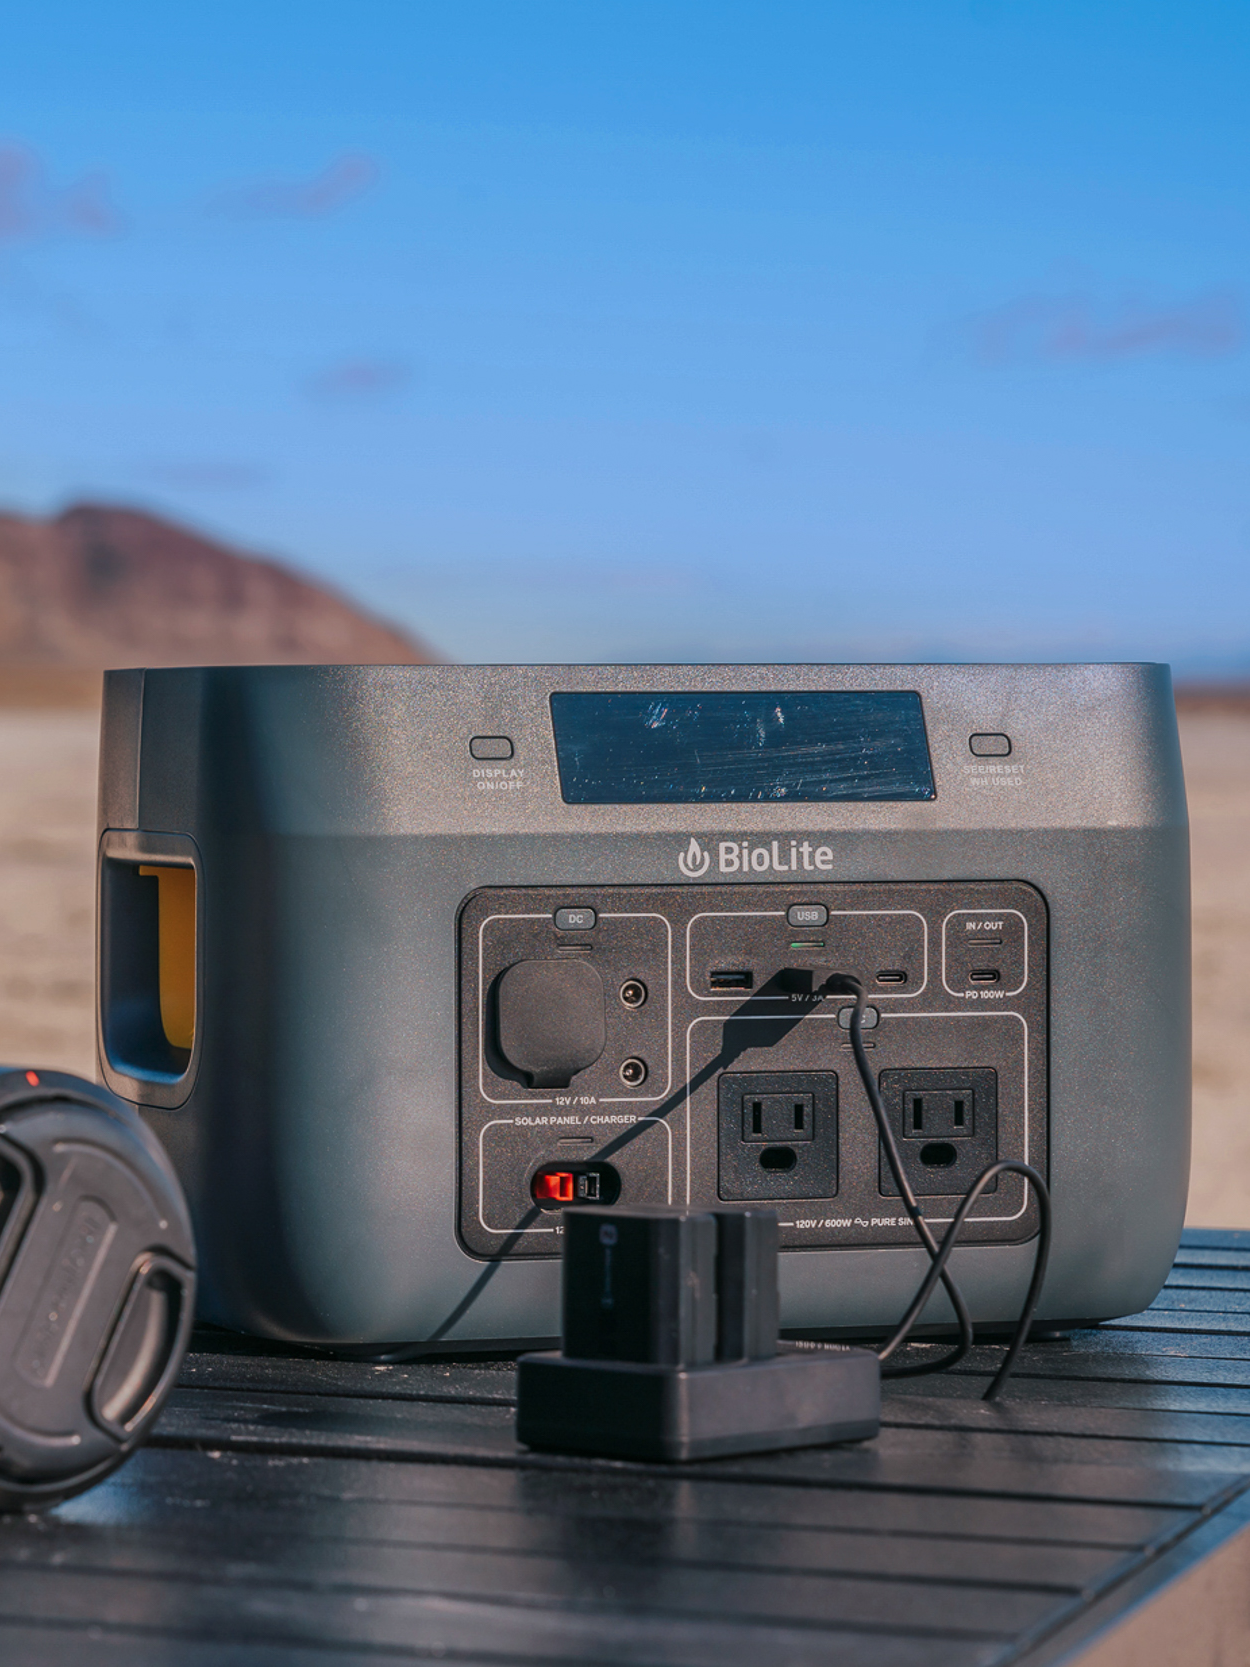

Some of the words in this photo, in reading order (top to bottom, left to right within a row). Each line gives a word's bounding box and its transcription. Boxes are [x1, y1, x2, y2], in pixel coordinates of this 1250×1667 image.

[472, 769, 524, 778] DISPLAY
[992, 777, 1023, 786] USED
[718, 840, 834, 873] BioLite
[568, 914, 584, 924] DC
[796, 911, 819, 921] USB
[983, 920, 1004, 930] OUT
[791, 993, 804, 1002] 5V
[965, 990, 978, 999] PD
[979, 990, 1005, 999] 100W
[555, 1096, 572, 1106] 12V
[579, 1096, 597, 1105] 10A
[514, 1116, 549, 1126] SOLAR
[550, 1115, 582, 1125] PANEL
[590, 1114, 637, 1124] CHARGER
[795, 1218, 817, 1229] 120V
[824, 1217, 852, 1228] 600W
[870, 1217, 897, 1227] PURE
[897, 1216, 914, 1226] SIN
